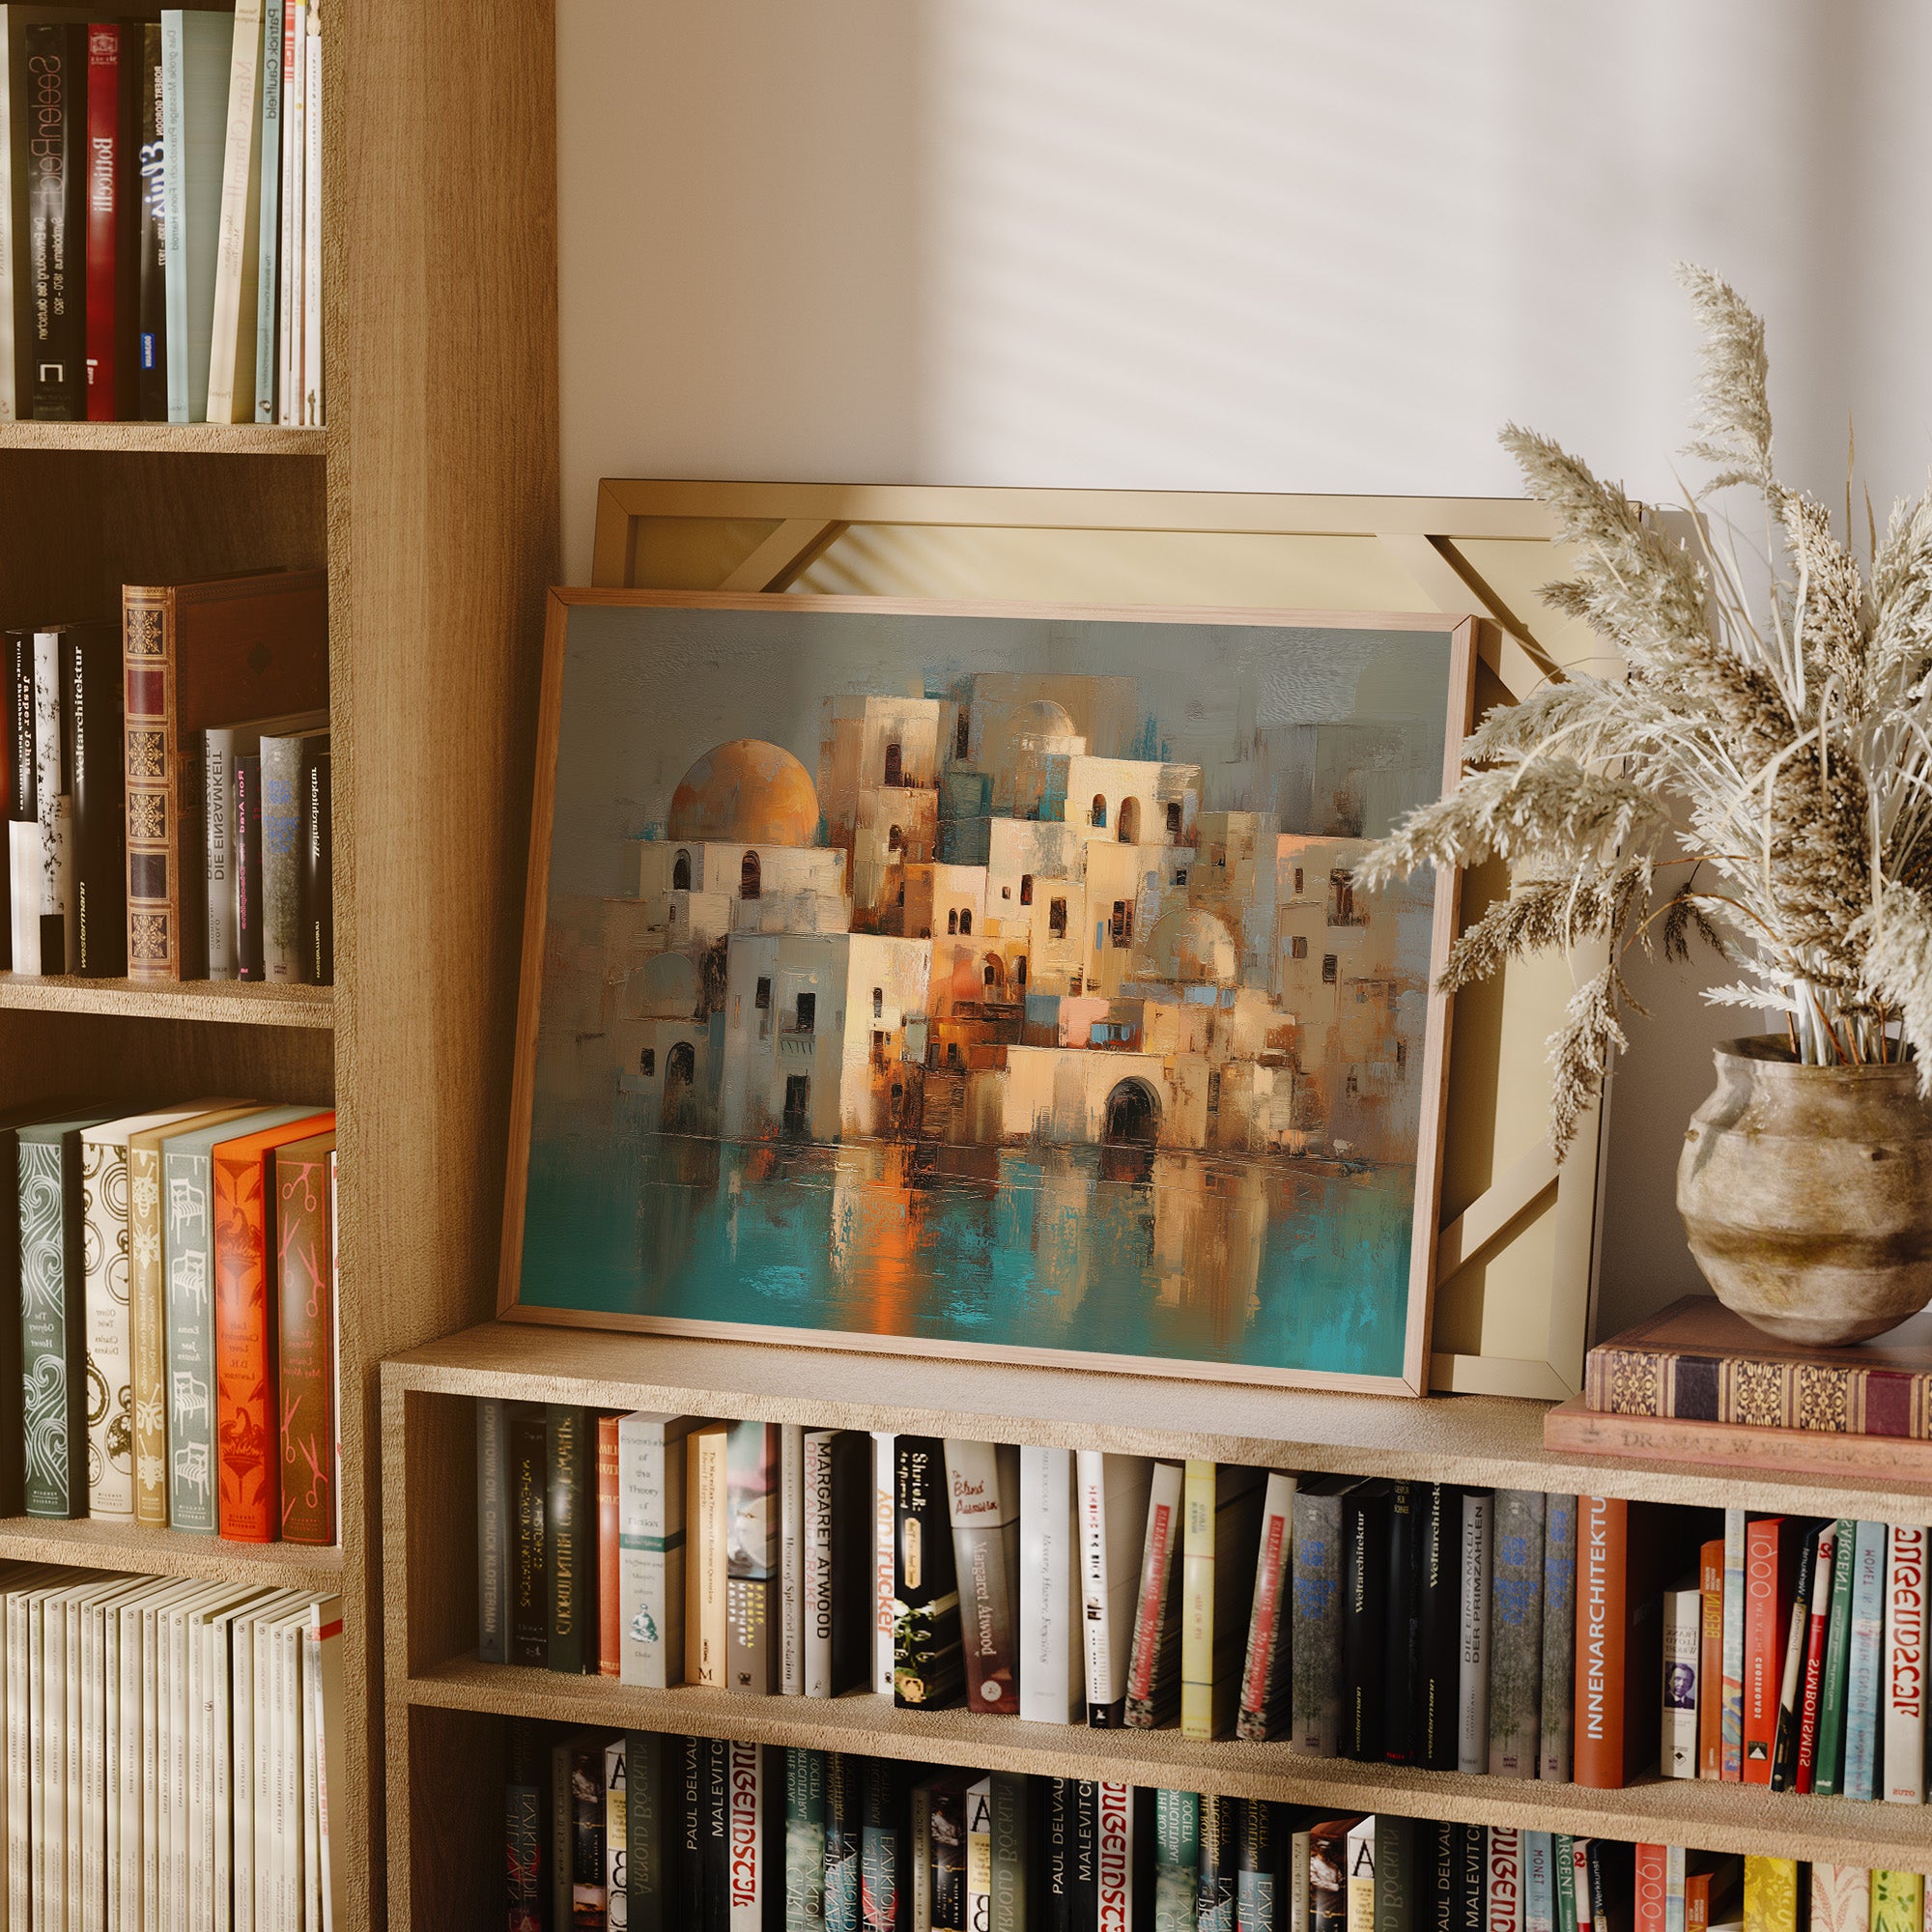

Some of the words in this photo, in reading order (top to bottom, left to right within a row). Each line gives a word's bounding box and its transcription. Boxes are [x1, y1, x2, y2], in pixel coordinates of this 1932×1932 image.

[22, 675, 31, 726] Jasper
[73, 645, 85, 783] Weltarchitektur
[23, 730, 32, 776] Johns
[80, 880, 89, 969] westermann
[484, 1405, 497, 1476] DOWNTOWN
[806, 1440, 816, 1492] ORYX
[484, 1479, 496, 1504] OWL
[806, 1497, 816, 1538] AND
[815, 1441, 830, 1551] MARGARET
[484, 1510, 496, 1551] CHUCK
[806, 1547, 816, 1612] CRAKE
[972, 1541, 989, 1600] Margaret
[1354, 1510, 1366, 1614] Weltarchitektur
[1463, 1520, 1474, 1630] EINSAMKEIT
[1471, 1505, 1483, 1622] PRIMZAHLEN
[484, 1554, 496, 1634] KLOSTERMAN
[815, 1556, 830, 1639] ATWOOD
[1587, 1495, 1607, 1740] INNENARCHITEKTU
[979, 1604, 997, 1657] Atwood
[1463, 1634, 1474, 1663] DIE
[1471, 1627, 1483, 1664] DER
[611, 1753, 627, 1791] A
[686, 1736, 697, 1803] DELVAU
[686, 1806, 697, 1851] PAUL
[970, 1794, 990, 1833] A
[1052, 1777, 1065, 1849] DELVAU
[1052, 1853, 1064, 1894] PAUL
[1354, 1838, 1376, 1878] A
[1438, 1823, 1450, 1908] DELVAU
[1533, 1849, 1543, 1887] MONET
[1575, 1852, 1586, 1868] 2
[1594, 1861, 1604, 1908] Werkkunst
[1642, 1855, 1662, 1919] 1900
